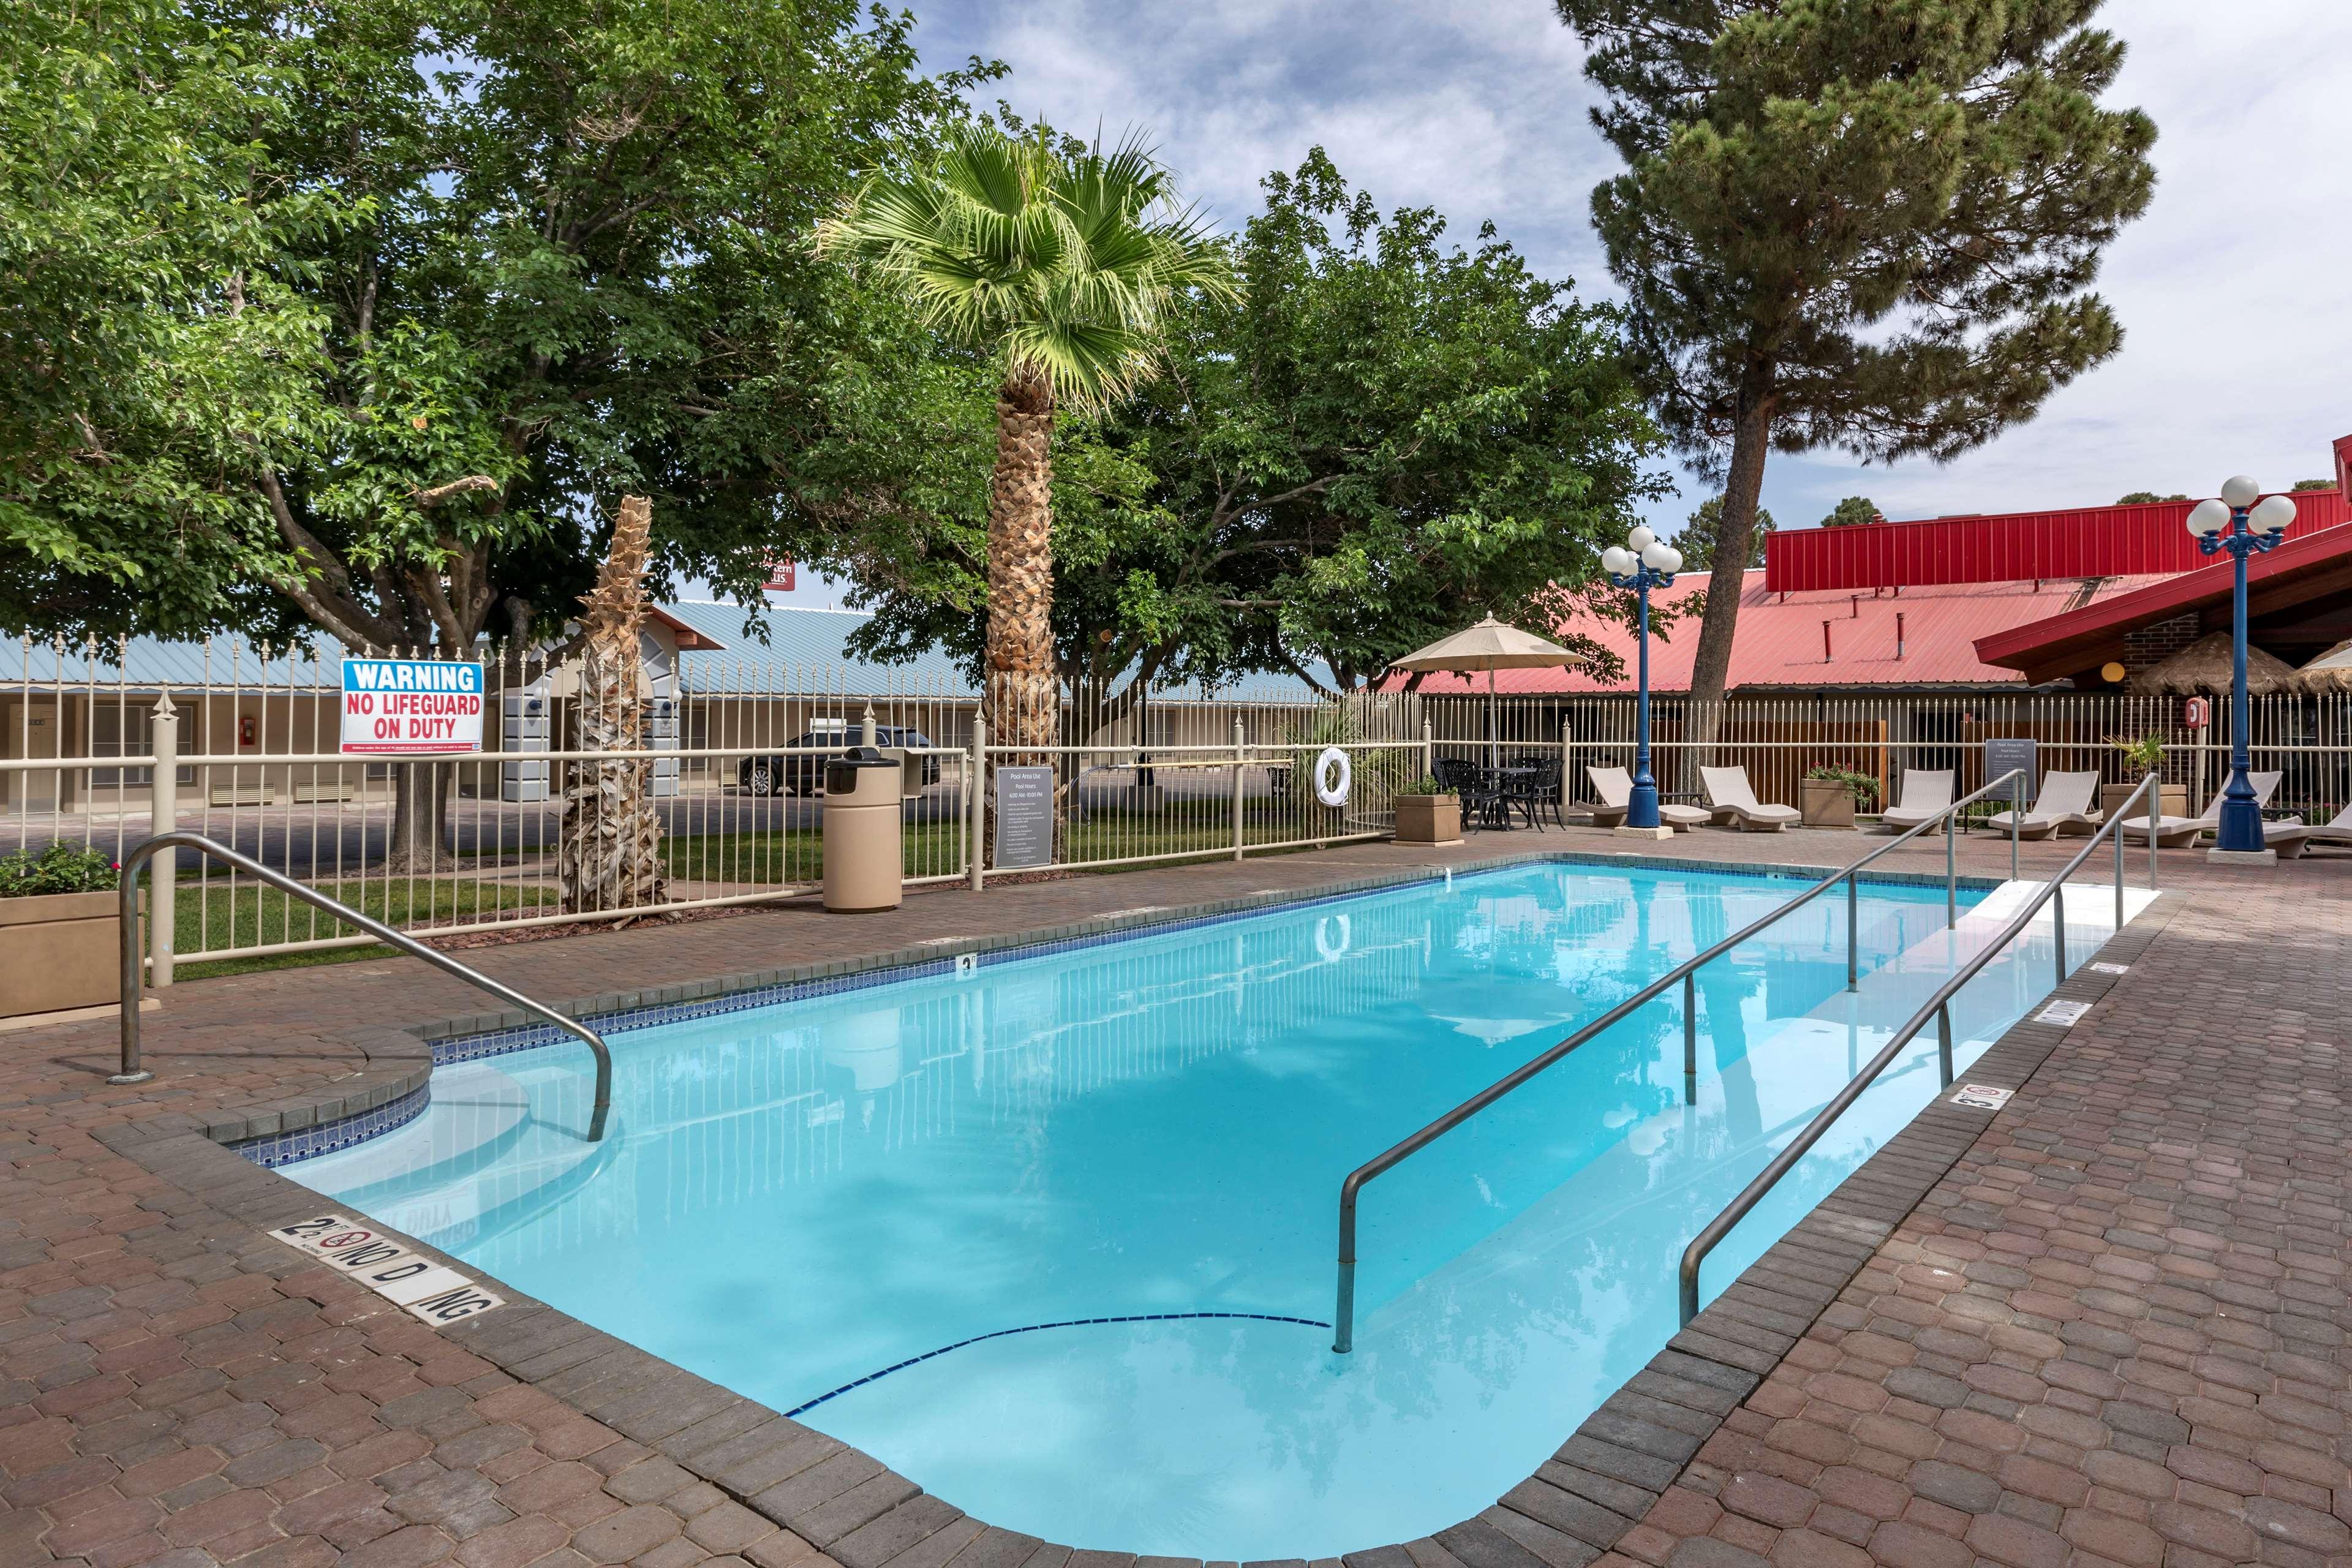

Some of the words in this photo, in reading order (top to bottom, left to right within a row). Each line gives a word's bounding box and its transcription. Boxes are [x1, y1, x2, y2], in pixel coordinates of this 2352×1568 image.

[352, 663, 474, 691] WARNING
[347, 693, 374, 715] NO
[383, 694, 480, 715] LIFEGUARD
[374, 718, 400, 739] ON
[409, 718, 456, 739] DUTY
[1958, 1098, 1993, 1107] 3
[332, 1242, 400, 1265] NO
